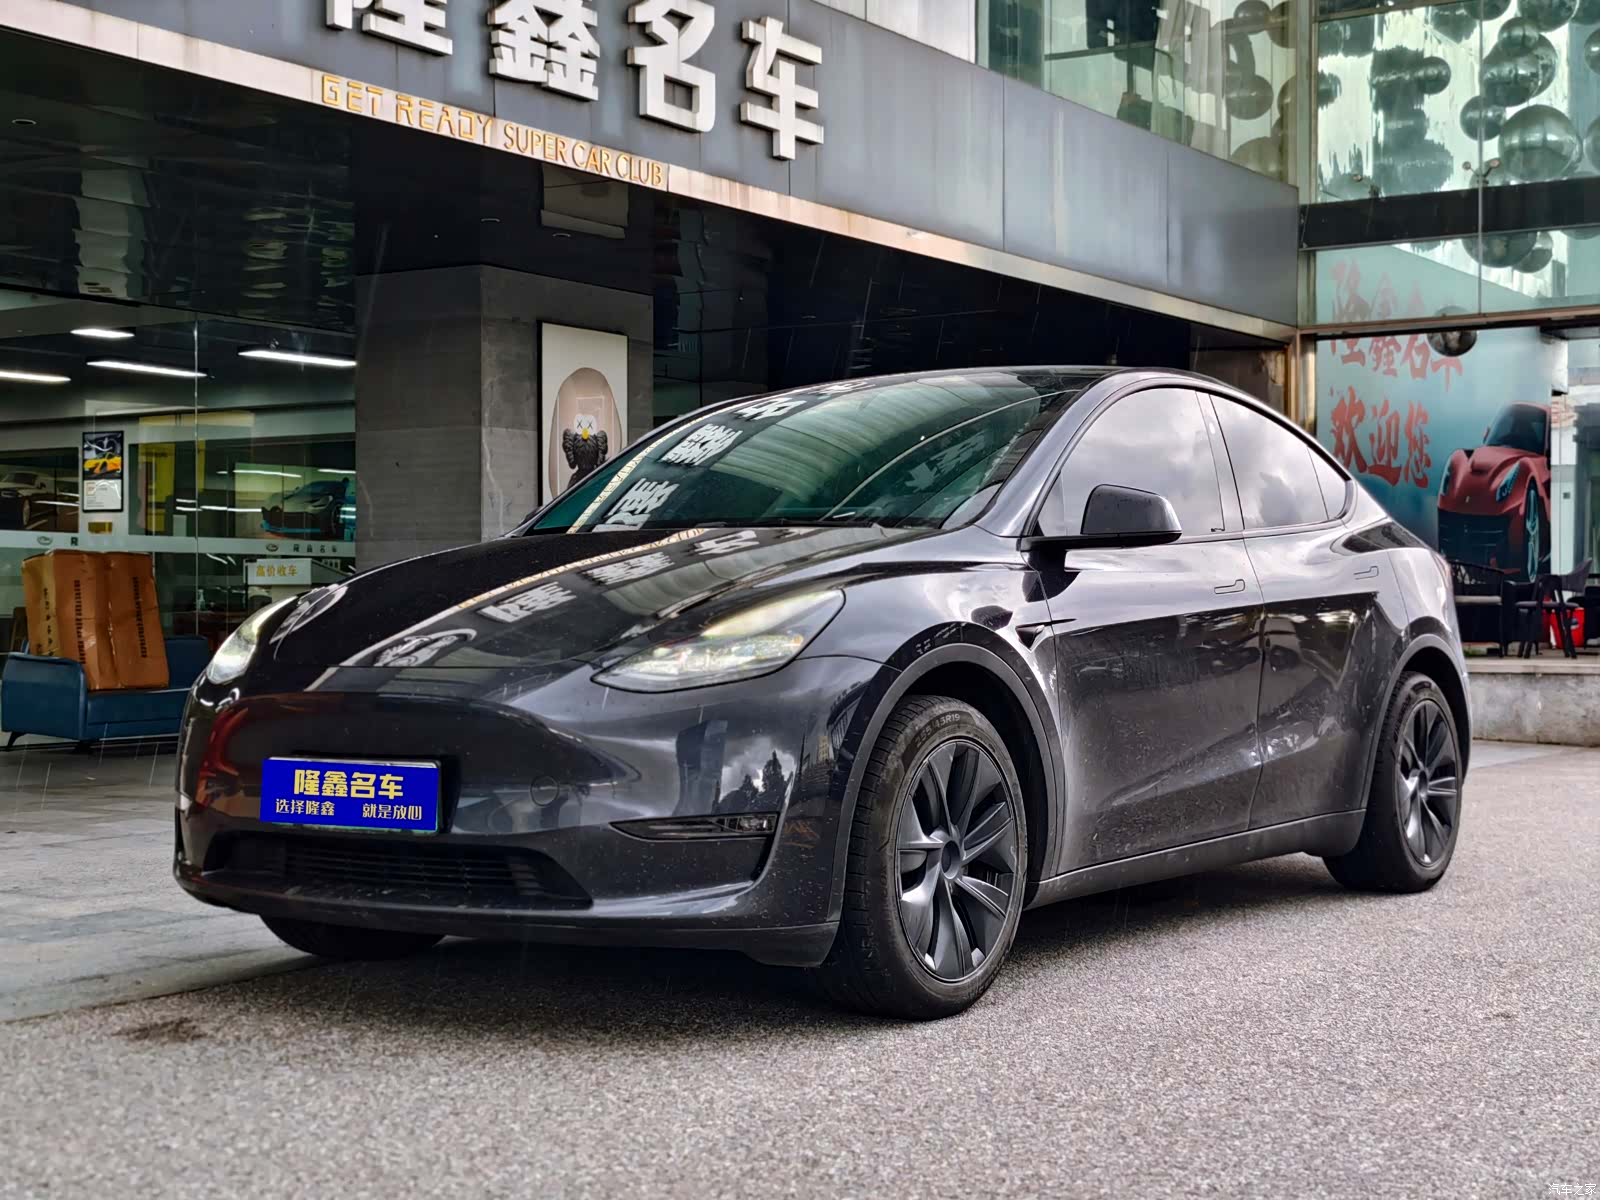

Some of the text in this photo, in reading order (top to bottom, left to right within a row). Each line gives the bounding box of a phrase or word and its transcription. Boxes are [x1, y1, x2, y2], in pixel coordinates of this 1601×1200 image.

[321, 74, 663, 187] GET READY SUPER CAR CLUB
[1329, 385, 1433, 488] 欢迎您
[275, 798, 422, 820] 选择隆鑫 就是放心
[294, 769, 404, 800] 隆鑫名车
